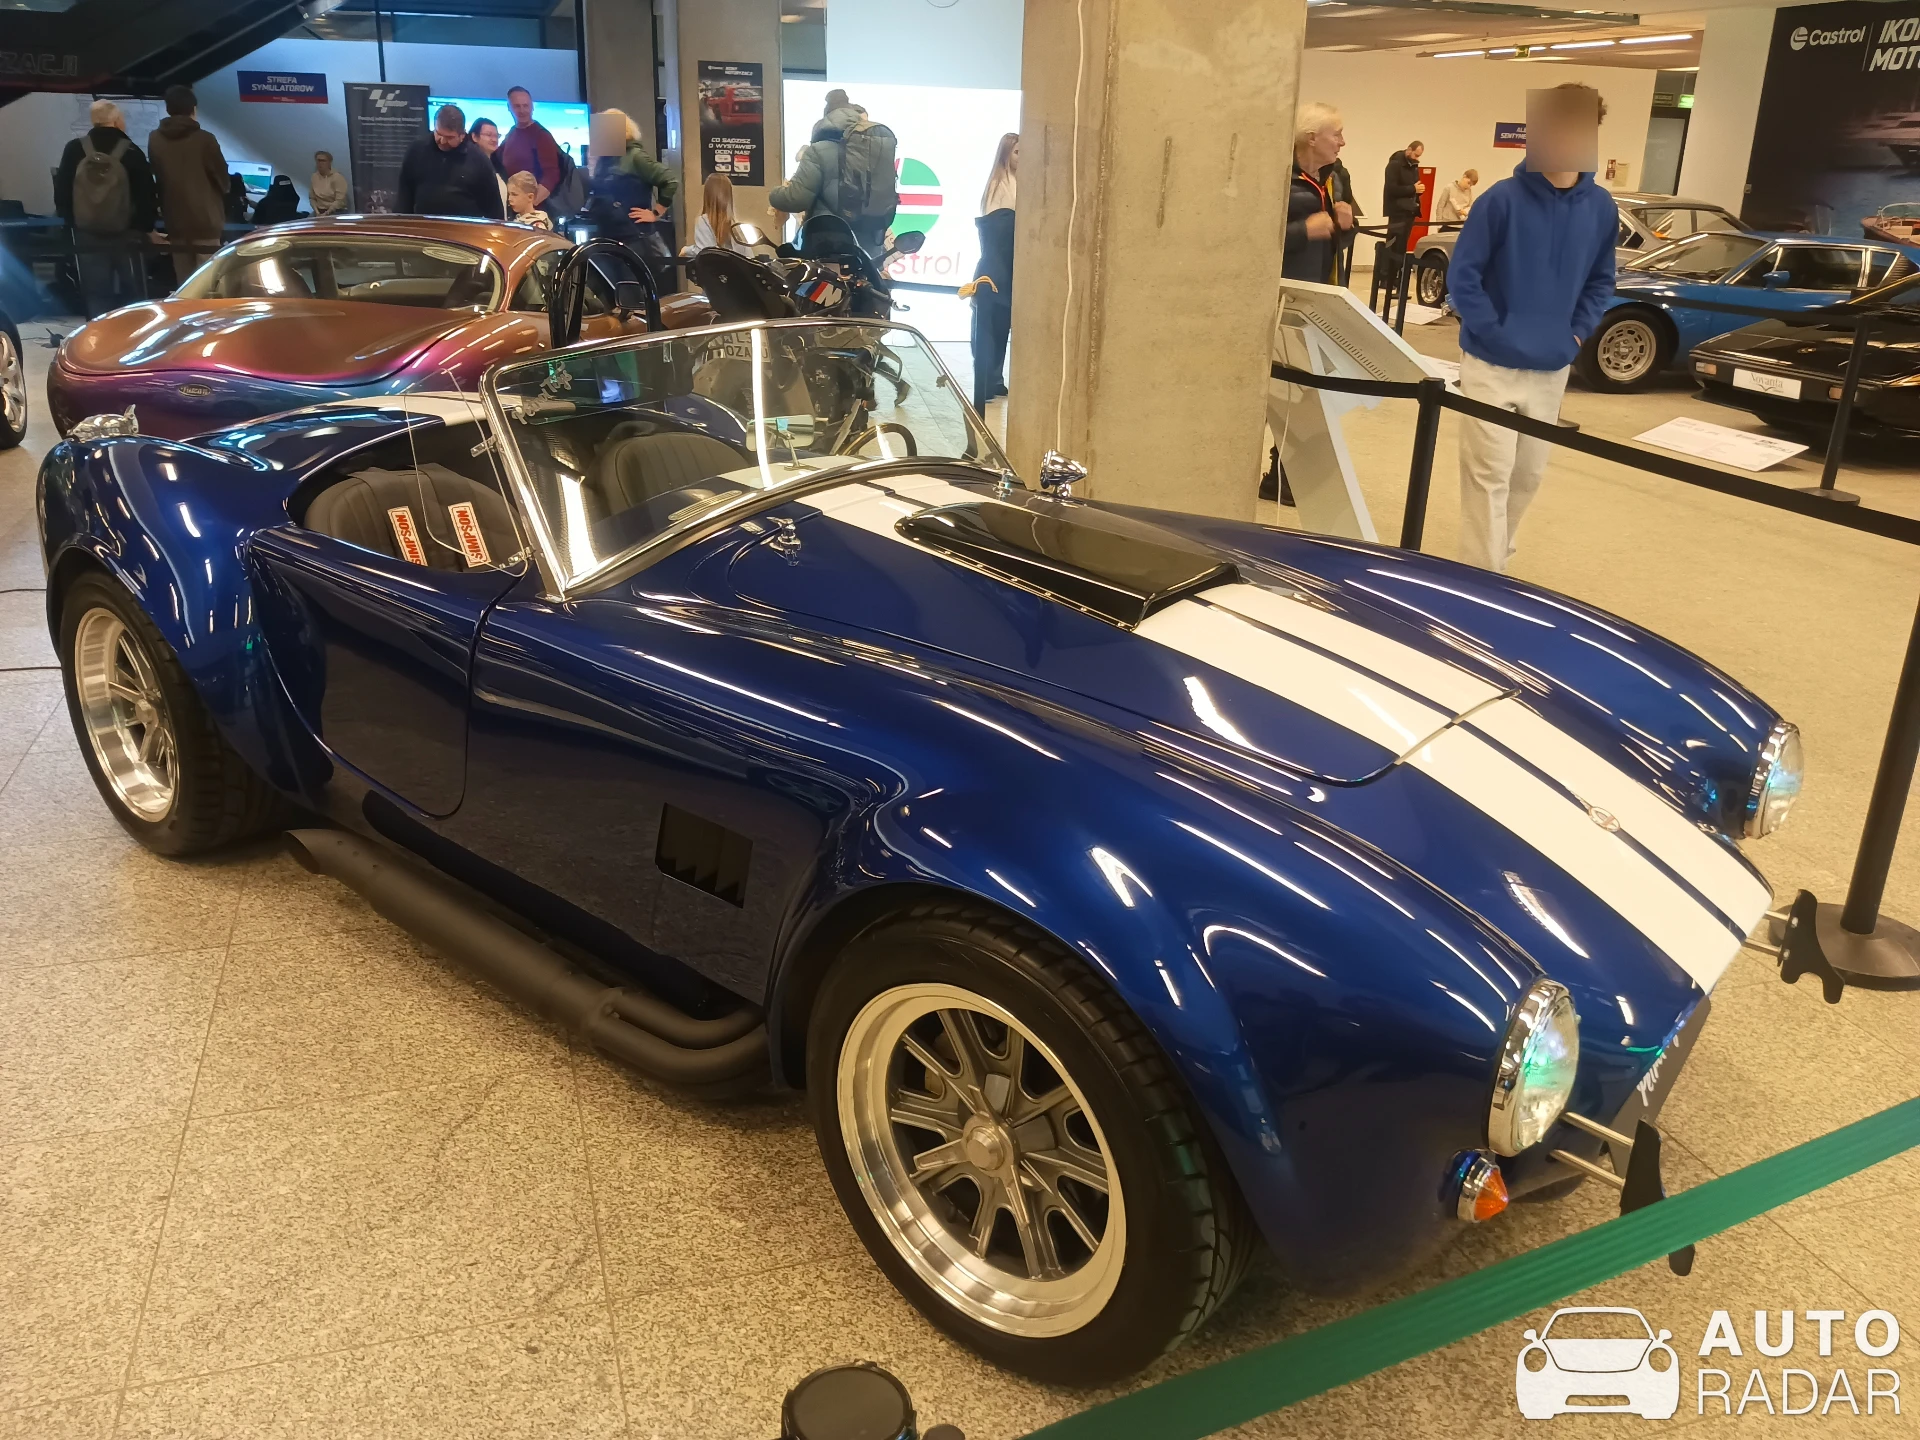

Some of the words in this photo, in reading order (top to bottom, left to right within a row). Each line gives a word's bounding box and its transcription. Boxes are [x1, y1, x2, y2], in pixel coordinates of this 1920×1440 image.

[1809, 25, 1866, 46] Castrol
[1868, 45, 1920, 72] MOT
[456, 510, 484, 561] SIMPSON
